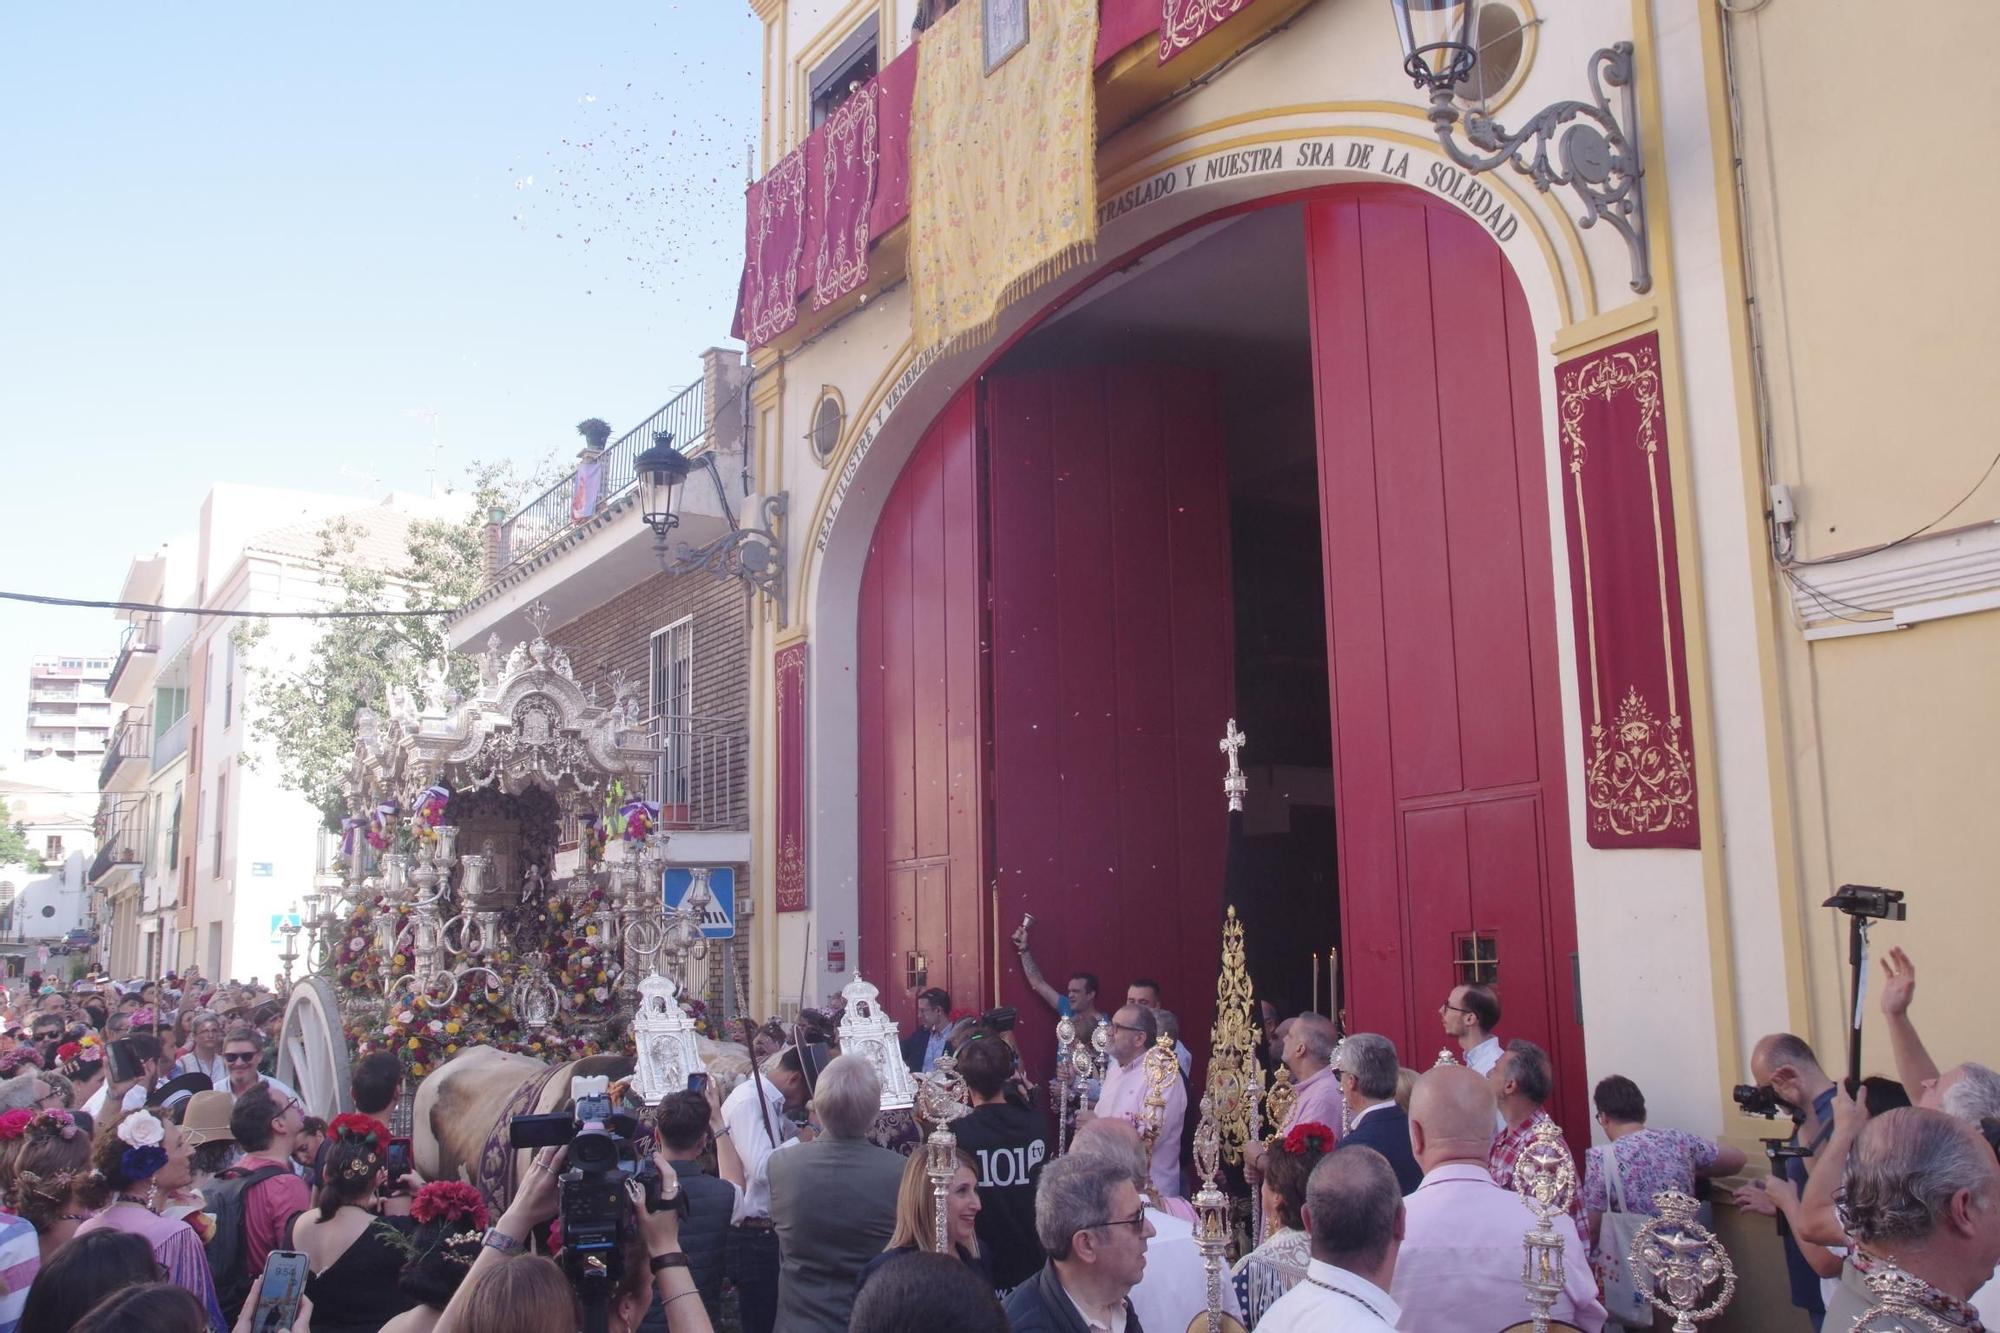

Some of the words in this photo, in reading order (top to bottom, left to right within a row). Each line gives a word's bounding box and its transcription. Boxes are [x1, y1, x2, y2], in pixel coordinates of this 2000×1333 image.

[816, 504, 838, 553] REAL
[836, 427, 874, 500] ILUSTRE
[875, 409, 883, 427] Y
[1098, 172, 1176, 227] TRASLADO
[1186, 164, 1197, 187] Y
[1205, 146, 1283, 181] NUESTRA
[1296, 142, 1335, 167] SRA
[1345, 142, 1375, 169] DE
[1381, 147, 1409, 179] LA
[1424, 161, 1518, 242] SOLEDAD
[976, 1147, 1030, 1187] 101
